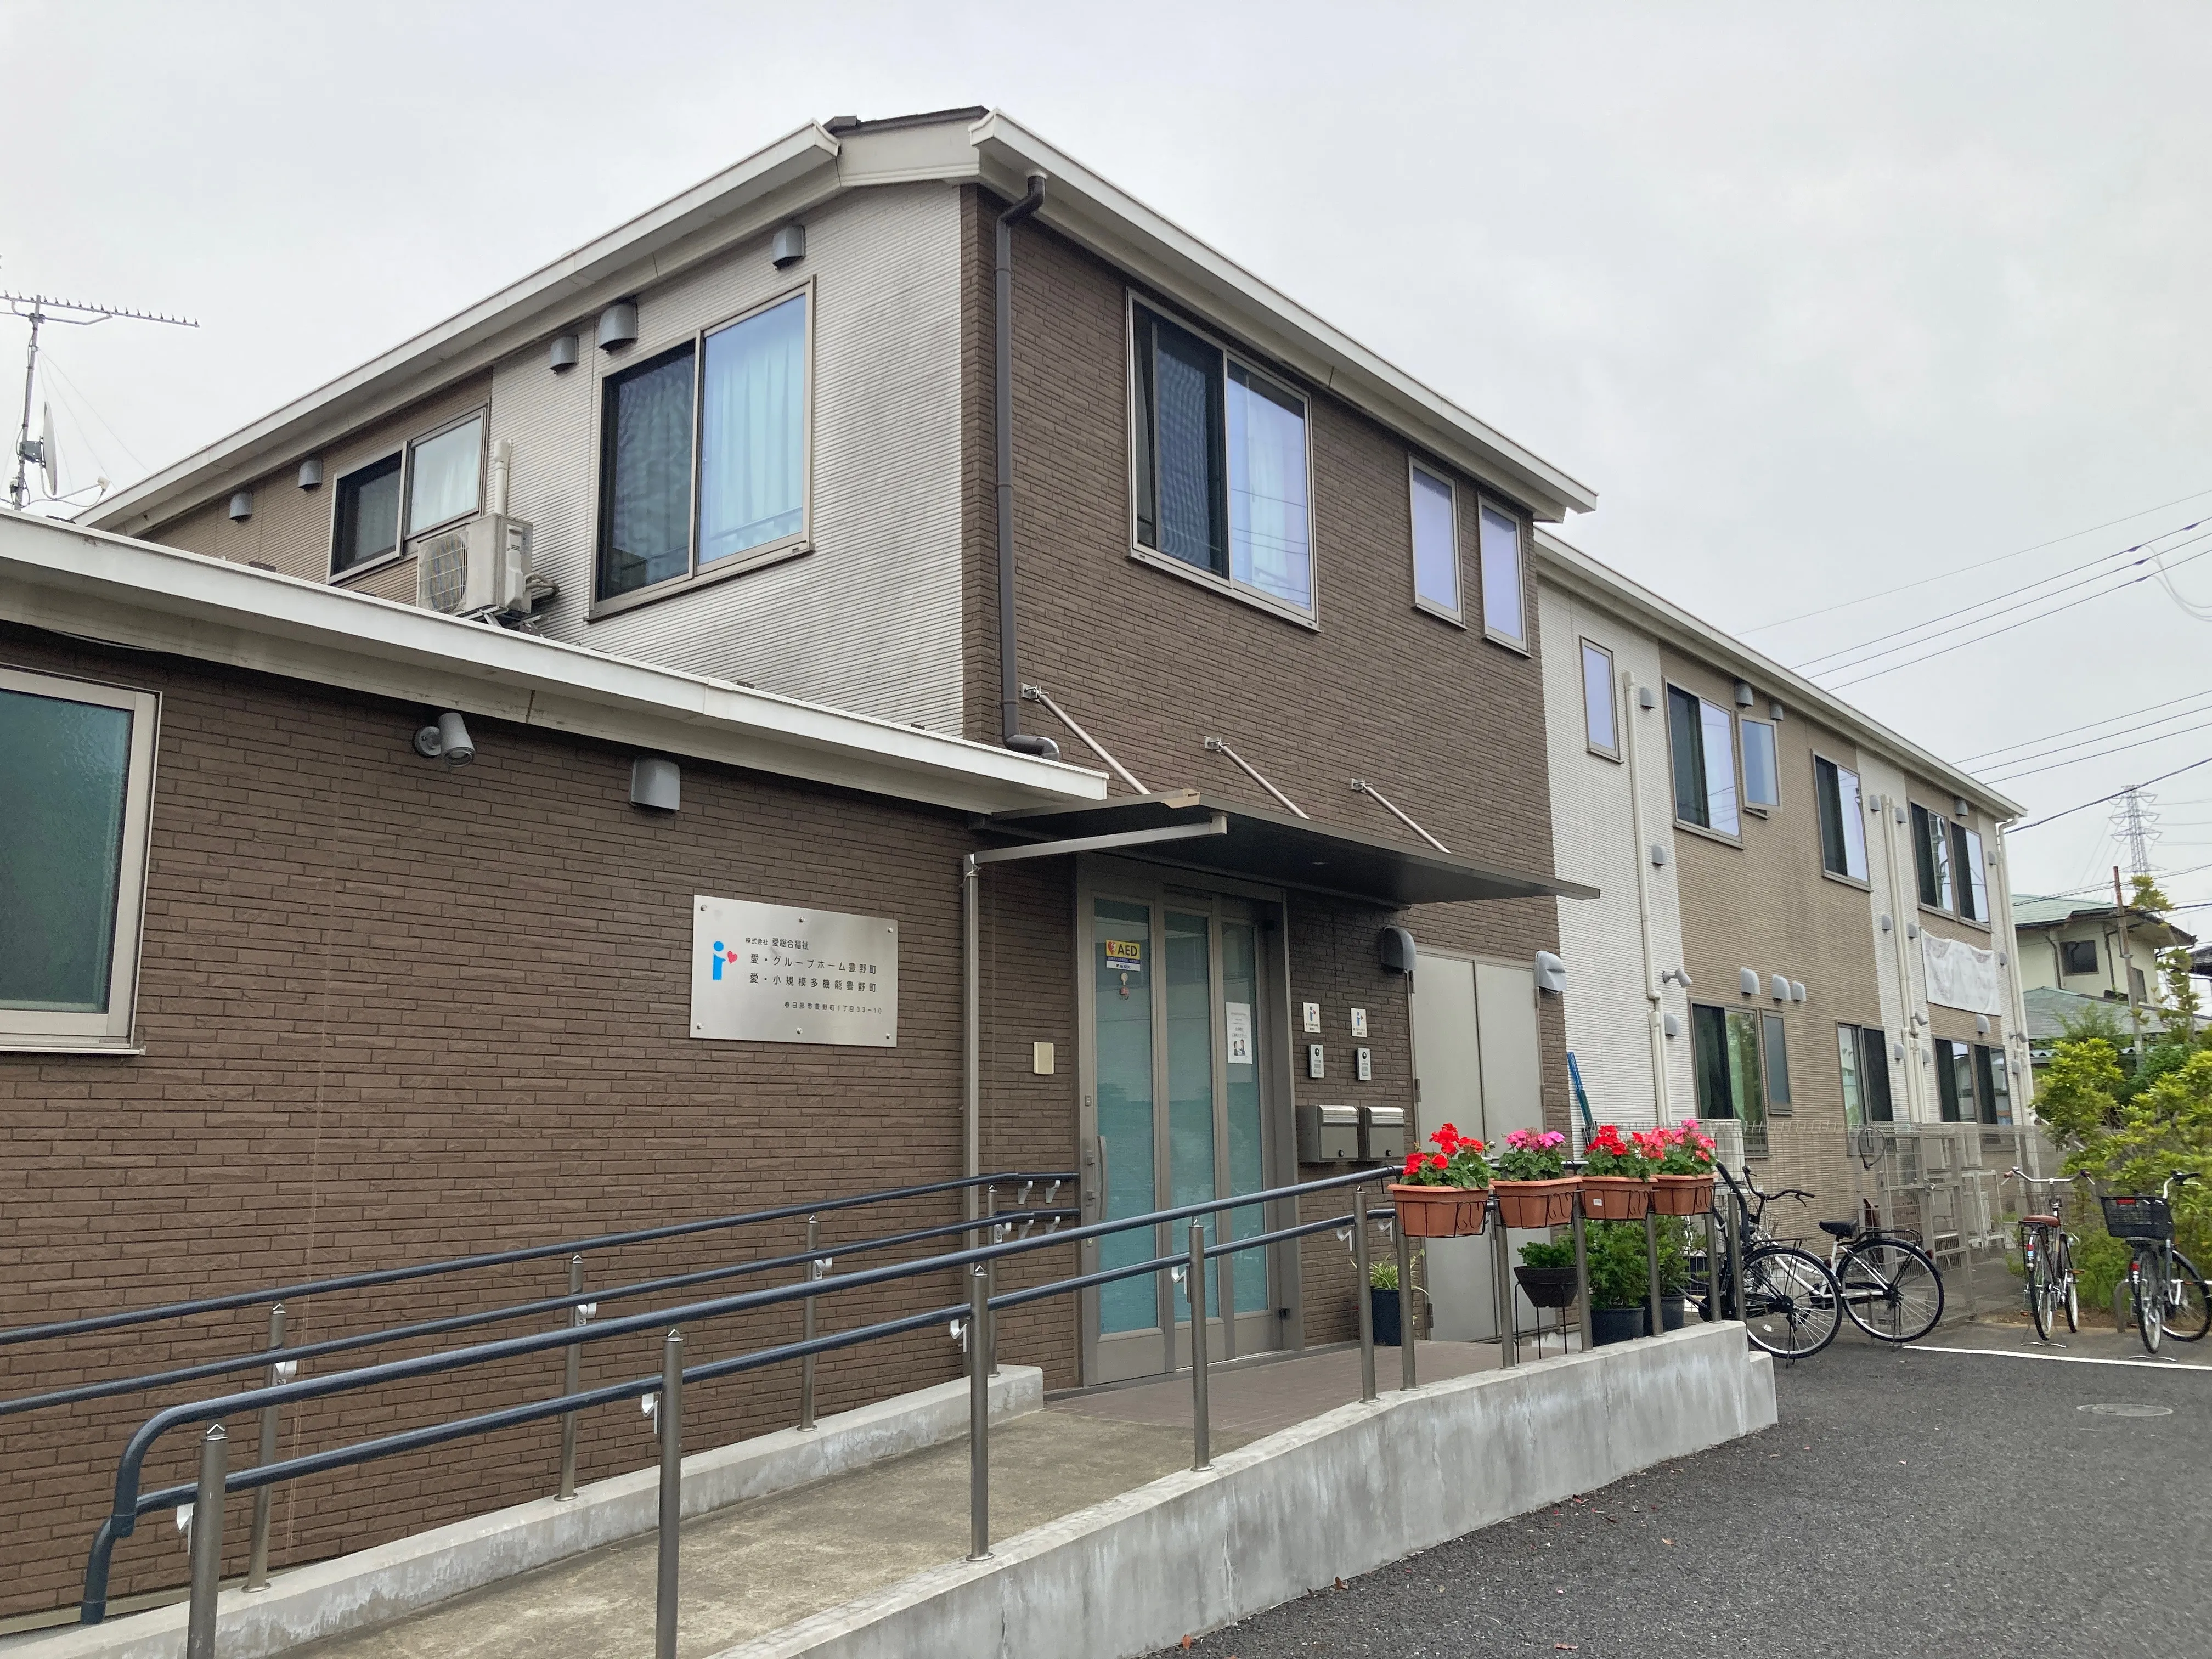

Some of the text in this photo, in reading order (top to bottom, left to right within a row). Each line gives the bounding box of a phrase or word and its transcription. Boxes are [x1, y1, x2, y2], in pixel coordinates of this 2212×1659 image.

[746, 937, 809, 950] 株式会社 愛総合福祉
[1118, 944, 1137, 956] AED
[750, 953, 877, 974] 愛・グループホーム豊野町
[749, 973, 877, 993] 愛・小規模多機能豊野町
